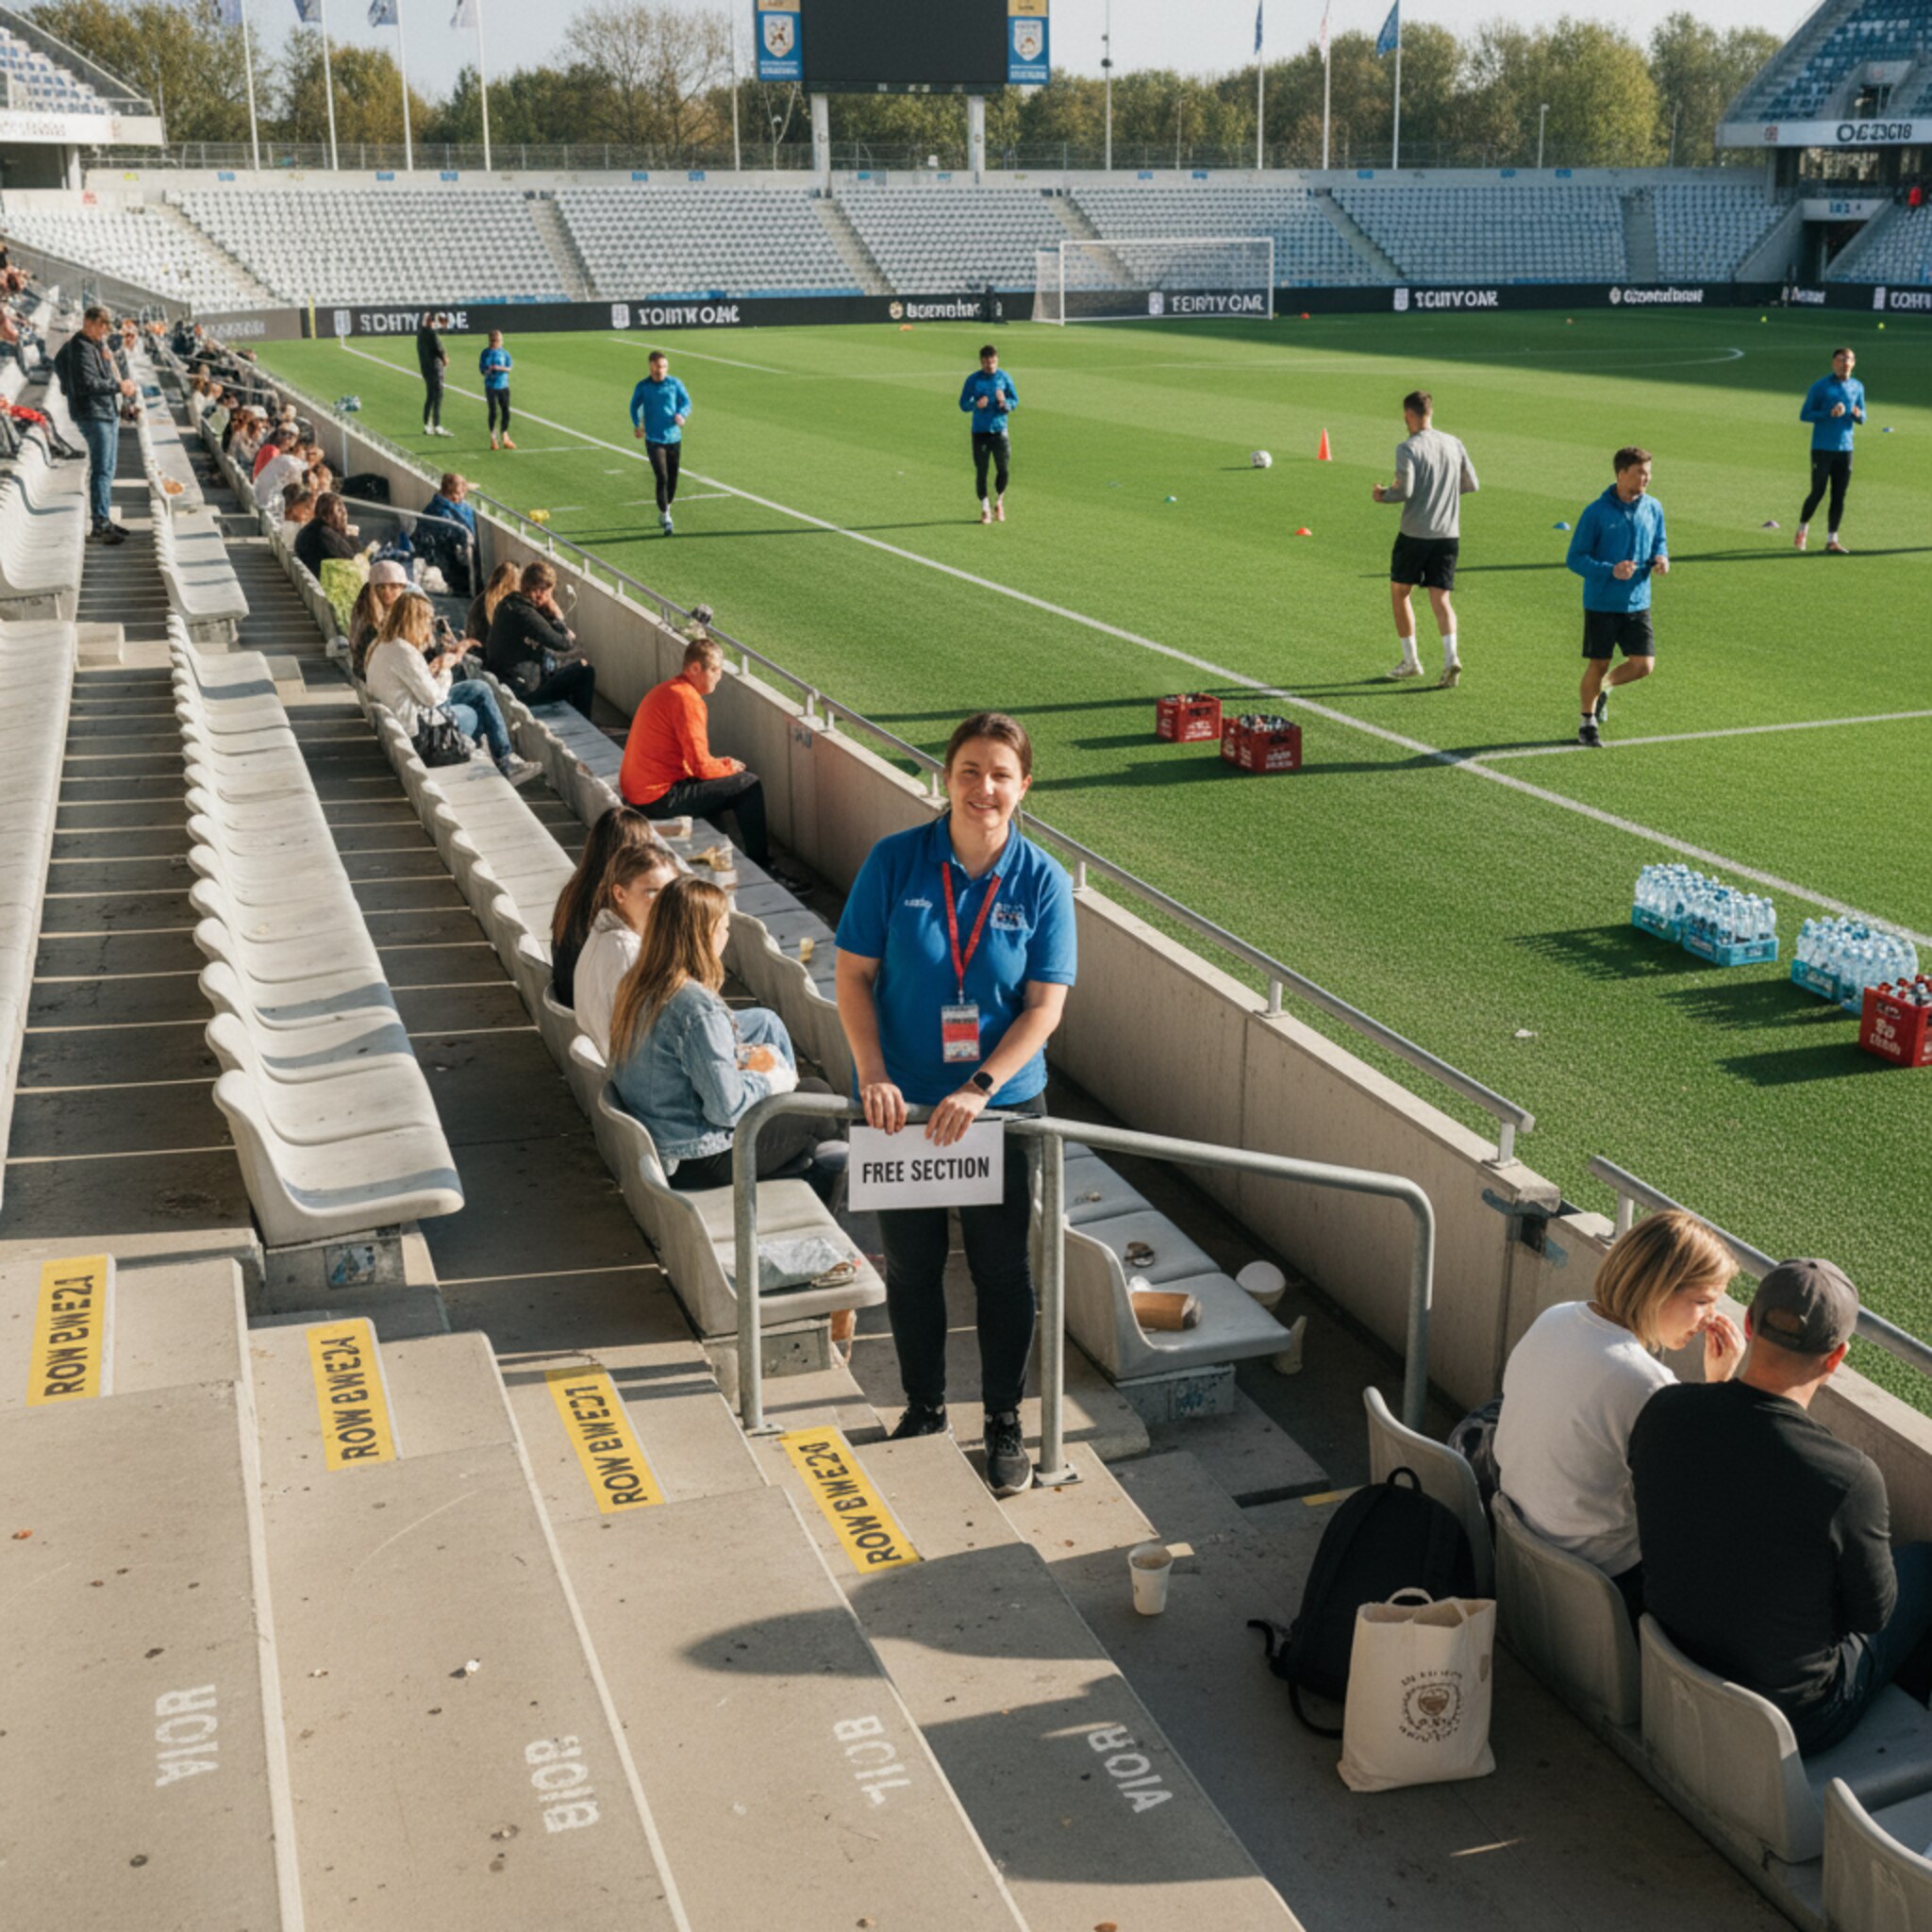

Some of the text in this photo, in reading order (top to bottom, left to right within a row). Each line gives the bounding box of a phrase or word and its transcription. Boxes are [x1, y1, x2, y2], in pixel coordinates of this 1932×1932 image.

[862, 1157, 990, 1184] FREE SECTION
[43, 1343, 88, 1397] ROW
[334, 1407, 379, 1460] ROW
[594, 1457, 648, 1506] ROW
[841, 1512, 903, 1565] ROW
